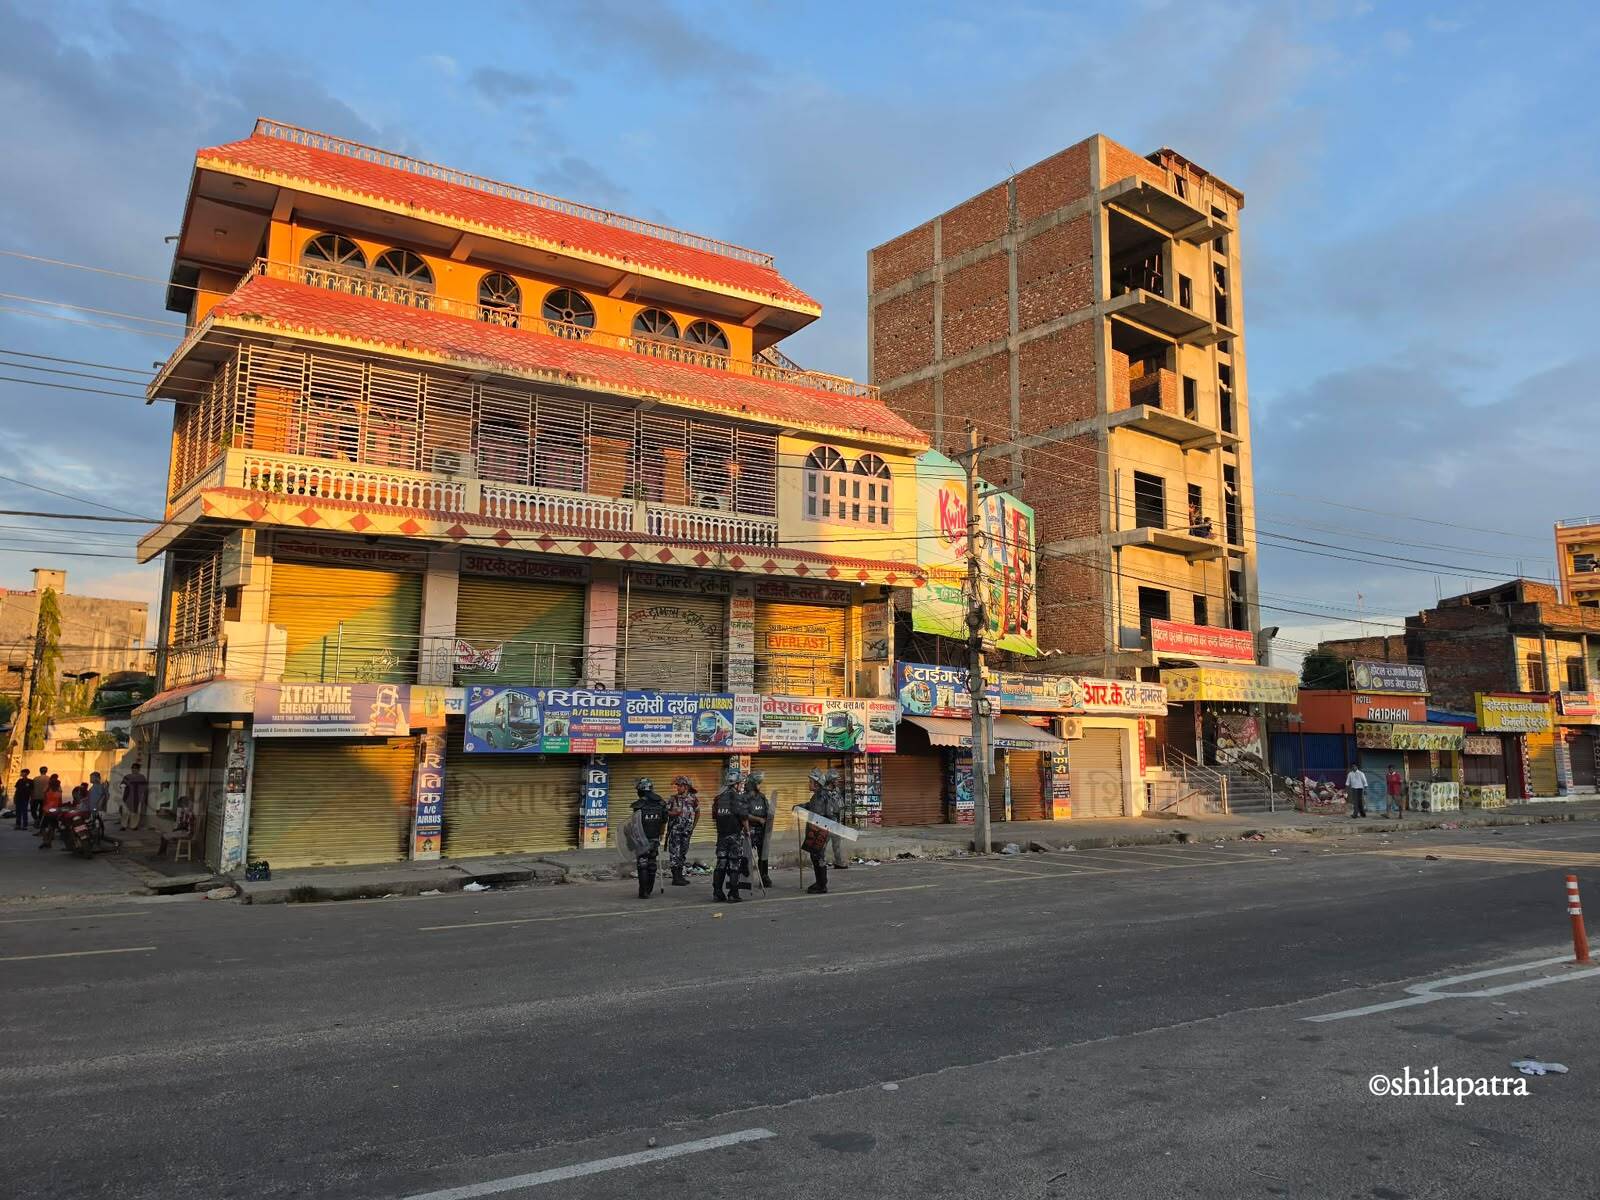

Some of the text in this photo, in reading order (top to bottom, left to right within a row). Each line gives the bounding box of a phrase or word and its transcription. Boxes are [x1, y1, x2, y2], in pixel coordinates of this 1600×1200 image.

[279, 685, 352, 703] XTREME
[547, 689, 623, 707] रितिक
[1355, 695, 1372, 704] HOTEL
[279, 703, 352, 714] ENERGY DRINK
[626, 694, 699, 715] हलेसी दर्शन
[763, 696, 823, 716] नेशनल
[572, 708, 622, 718] A/C AIRBUS
[1368, 707, 1410, 721] RAJDHANI
[417, 814, 442, 824] AIRBUS
